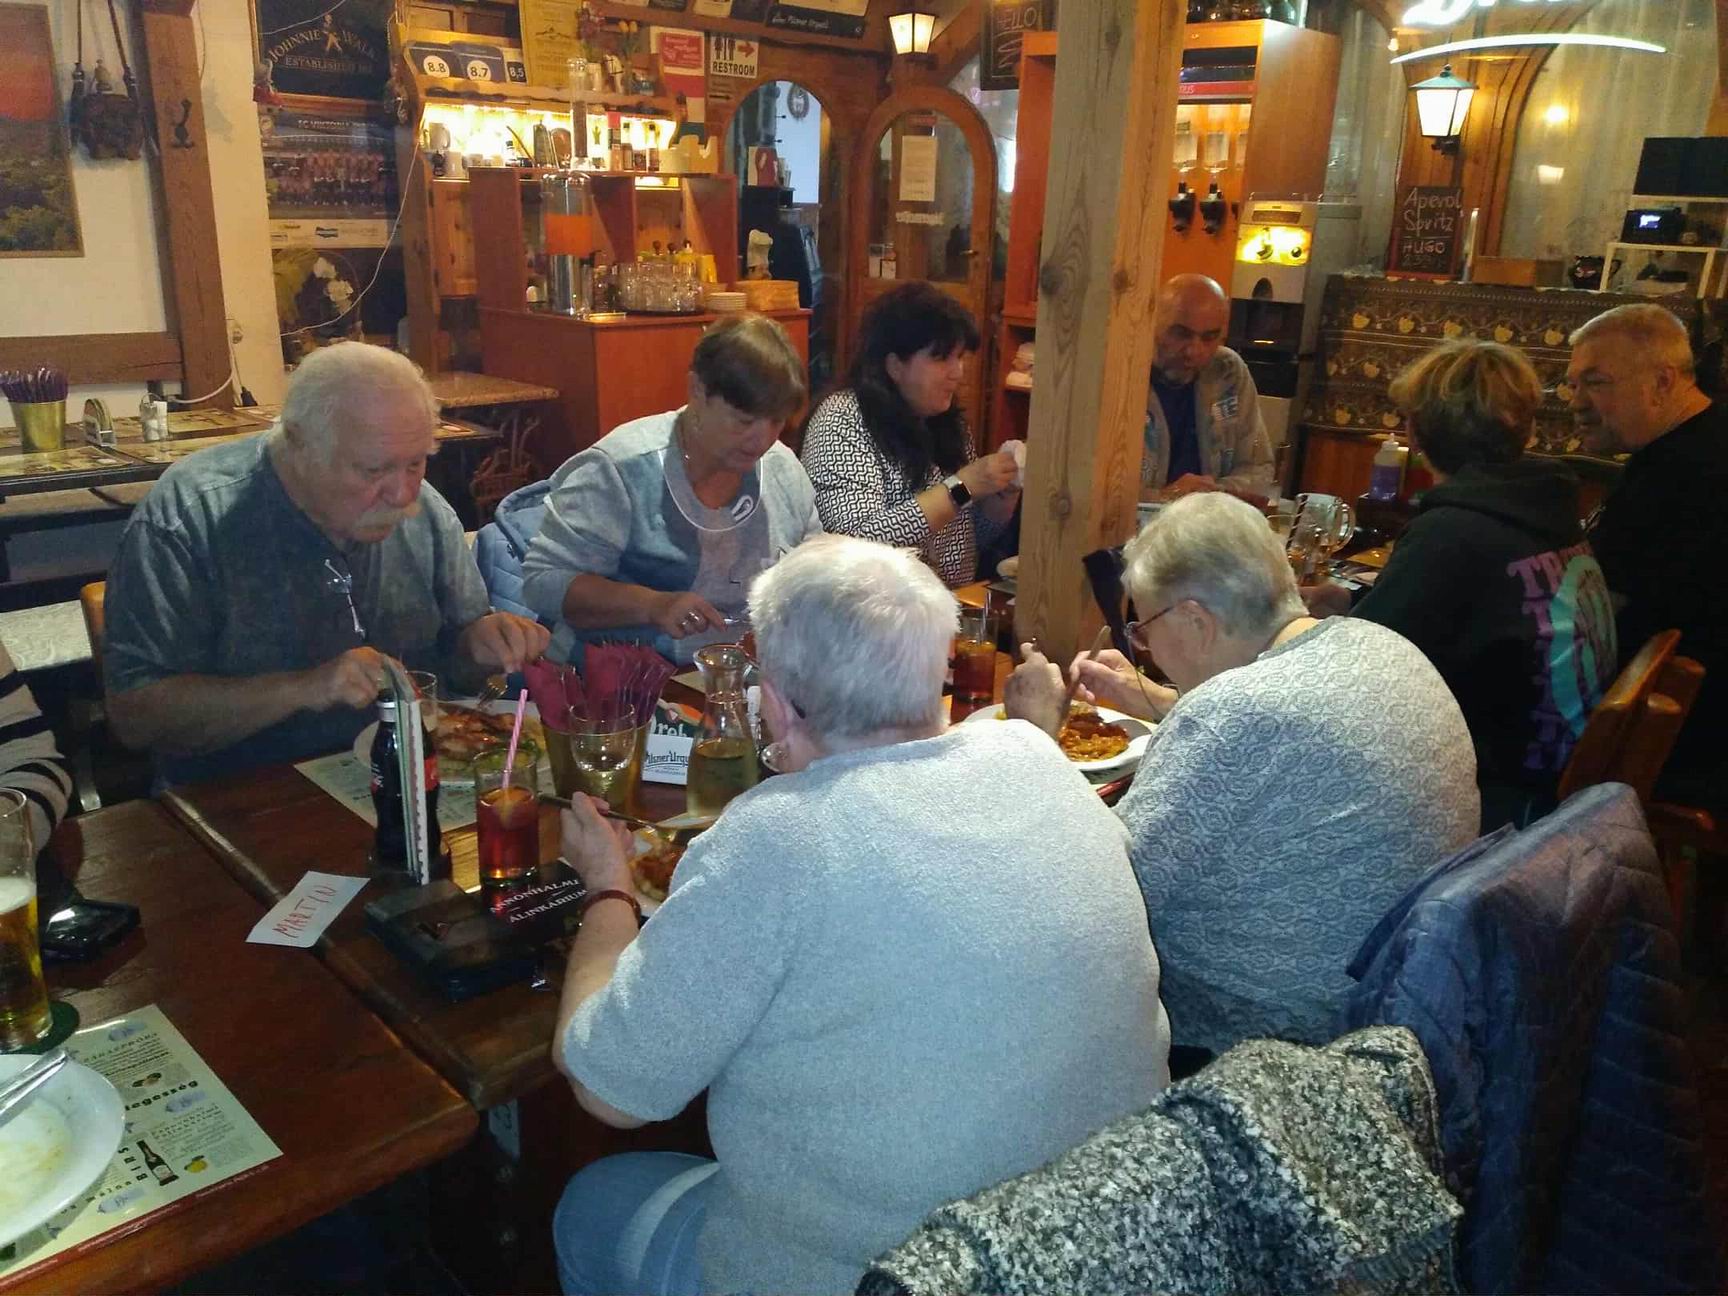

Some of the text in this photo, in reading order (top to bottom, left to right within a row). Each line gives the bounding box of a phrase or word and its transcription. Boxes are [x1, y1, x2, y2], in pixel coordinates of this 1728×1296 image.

[268, 29, 321, 63] JOHNNIE
[427, 62, 446, 73] 8.8
[470, 67, 488, 78] 8.7
[712, 61, 755, 76] RESTROOM
[1404, 187, 1462, 211] Aperol
[1403, 209, 1454, 237] Spritz
[1403, 240, 1446, 255] HUGO
[489, 879, 580, 913] ANNONHALMI
